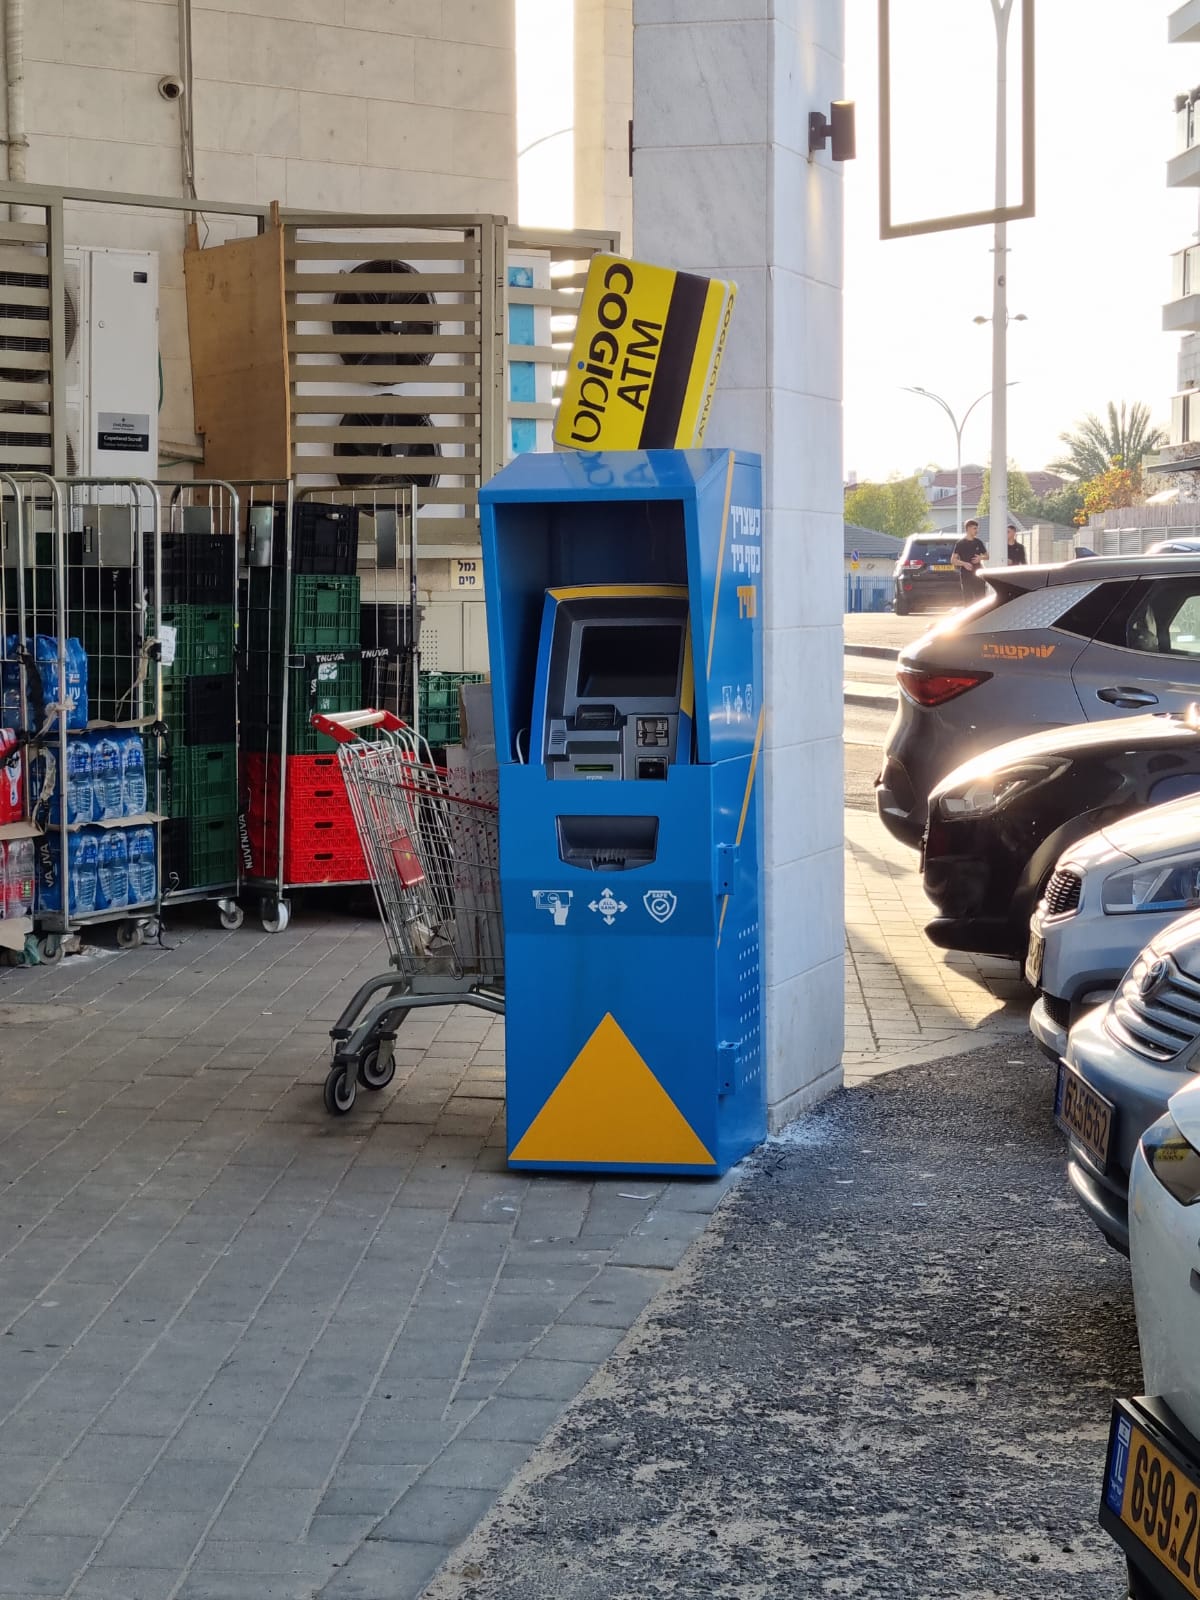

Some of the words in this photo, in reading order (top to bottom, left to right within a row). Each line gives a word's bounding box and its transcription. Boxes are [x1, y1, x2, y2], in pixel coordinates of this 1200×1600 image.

[616, 318, 663, 412] ATM
[698, 394, 712, 438] ATM
[731, 505, 760, 539] כשצריך
[458, 560, 476, 572] גמל
[745, 545, 760, 578] כסף
[458, 575, 476, 585] מים
[316, 653, 345, 662] TNUVA
[361, 648, 389, 659] TNUVA
